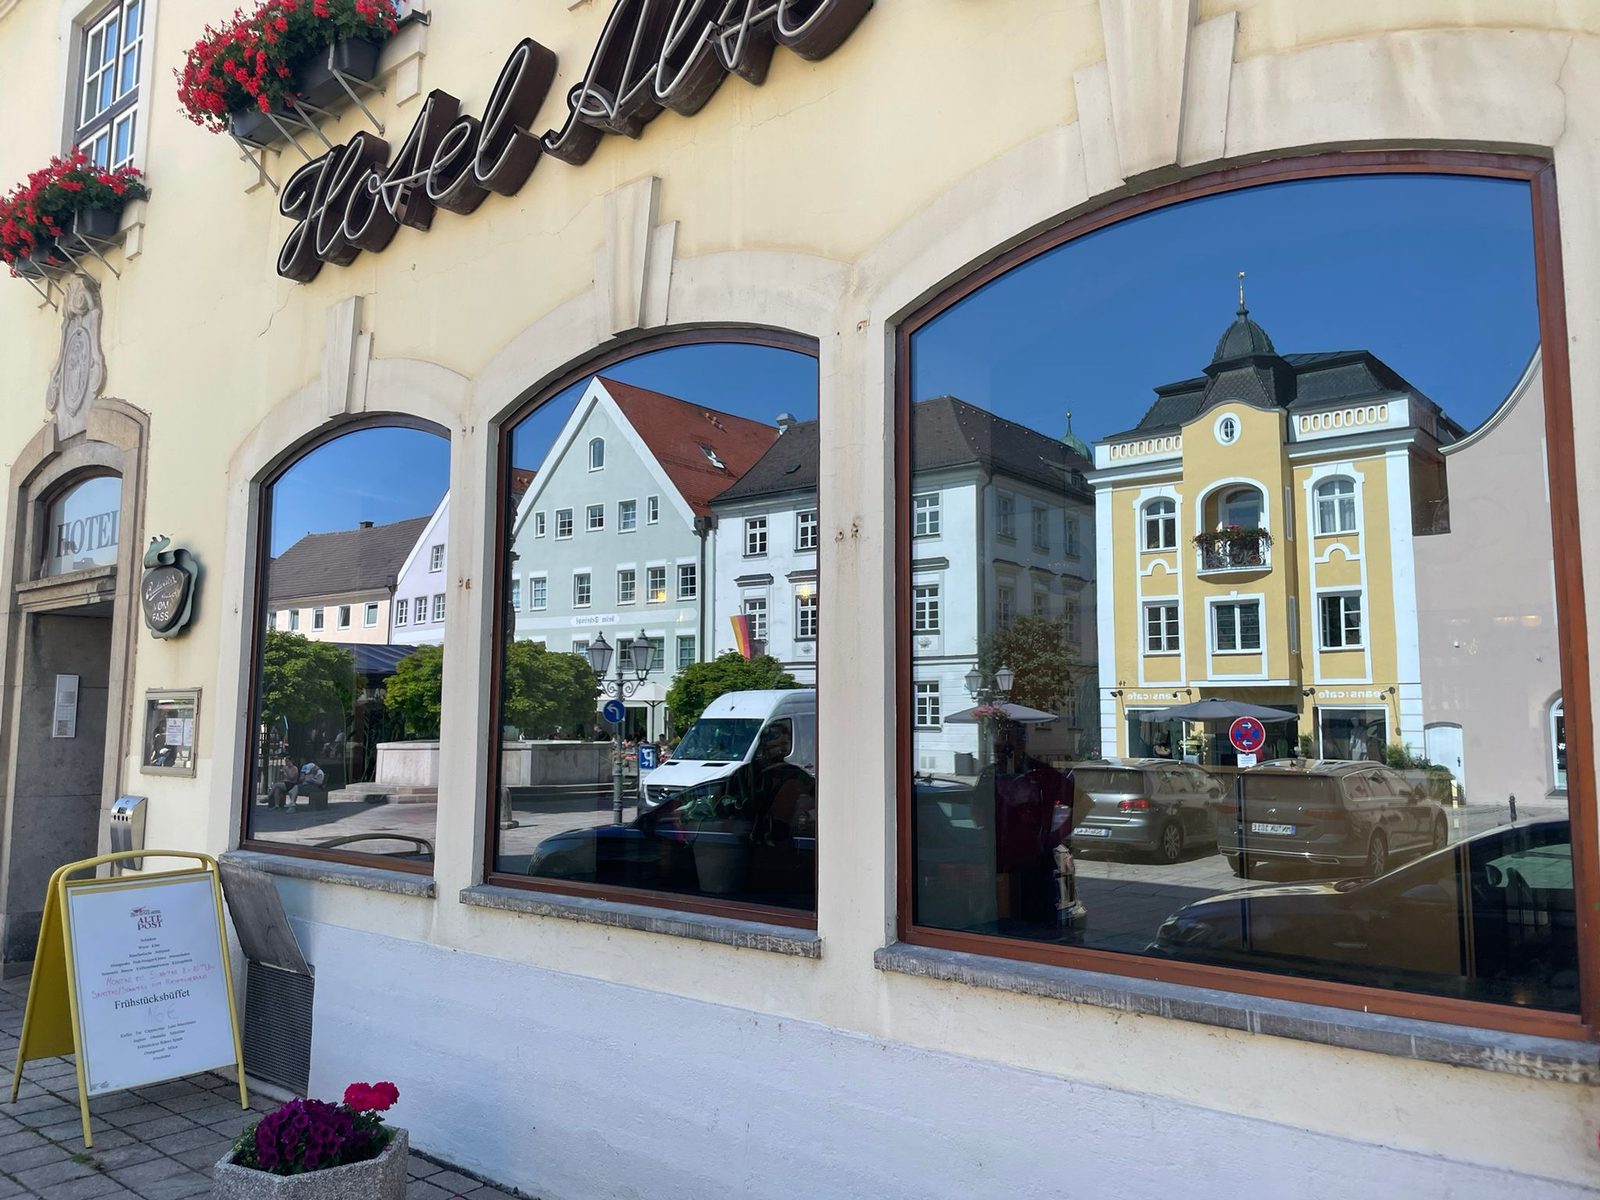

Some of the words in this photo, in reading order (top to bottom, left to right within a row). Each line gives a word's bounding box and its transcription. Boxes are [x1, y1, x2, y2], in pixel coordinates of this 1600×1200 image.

[277, 37, 556, 283] Hotel
[56, 510, 119, 557] HOTEL
[152, 611, 169, 621] FASS
[137, 921, 163, 931] POST
[138, 914, 163, 924] ALTE
[114, 988, 190, 1010] Frühstücksbüffet
